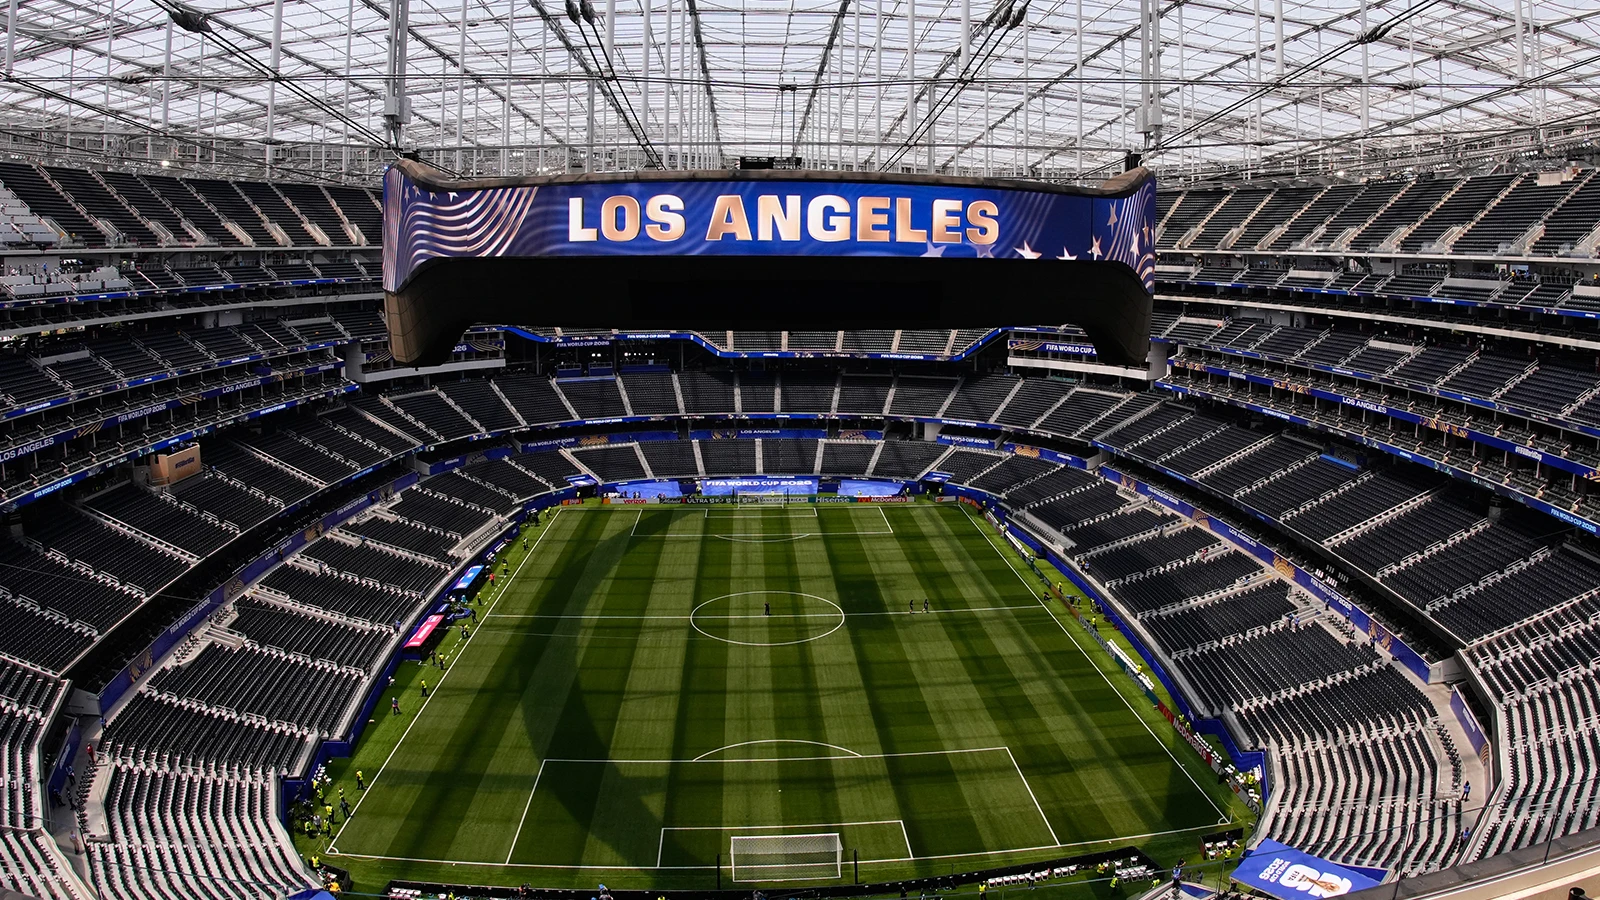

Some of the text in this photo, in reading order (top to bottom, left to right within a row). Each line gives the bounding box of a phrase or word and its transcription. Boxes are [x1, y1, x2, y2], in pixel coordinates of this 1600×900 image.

[567, 194, 1000, 245] LOS ANGELES
[235, 380, 260, 390] ANGELES
[118, 404, 166, 422] FIFA WORLD CUP 2026
[1342, 396, 1387, 414] LOS ANGELES
[0, 437, 54, 462] LOS ANGELES
[1551, 508, 1559, 516] FIFA
[1573, 516, 1582, 525] CUP
[1258, 858, 1284, 880] 2026
